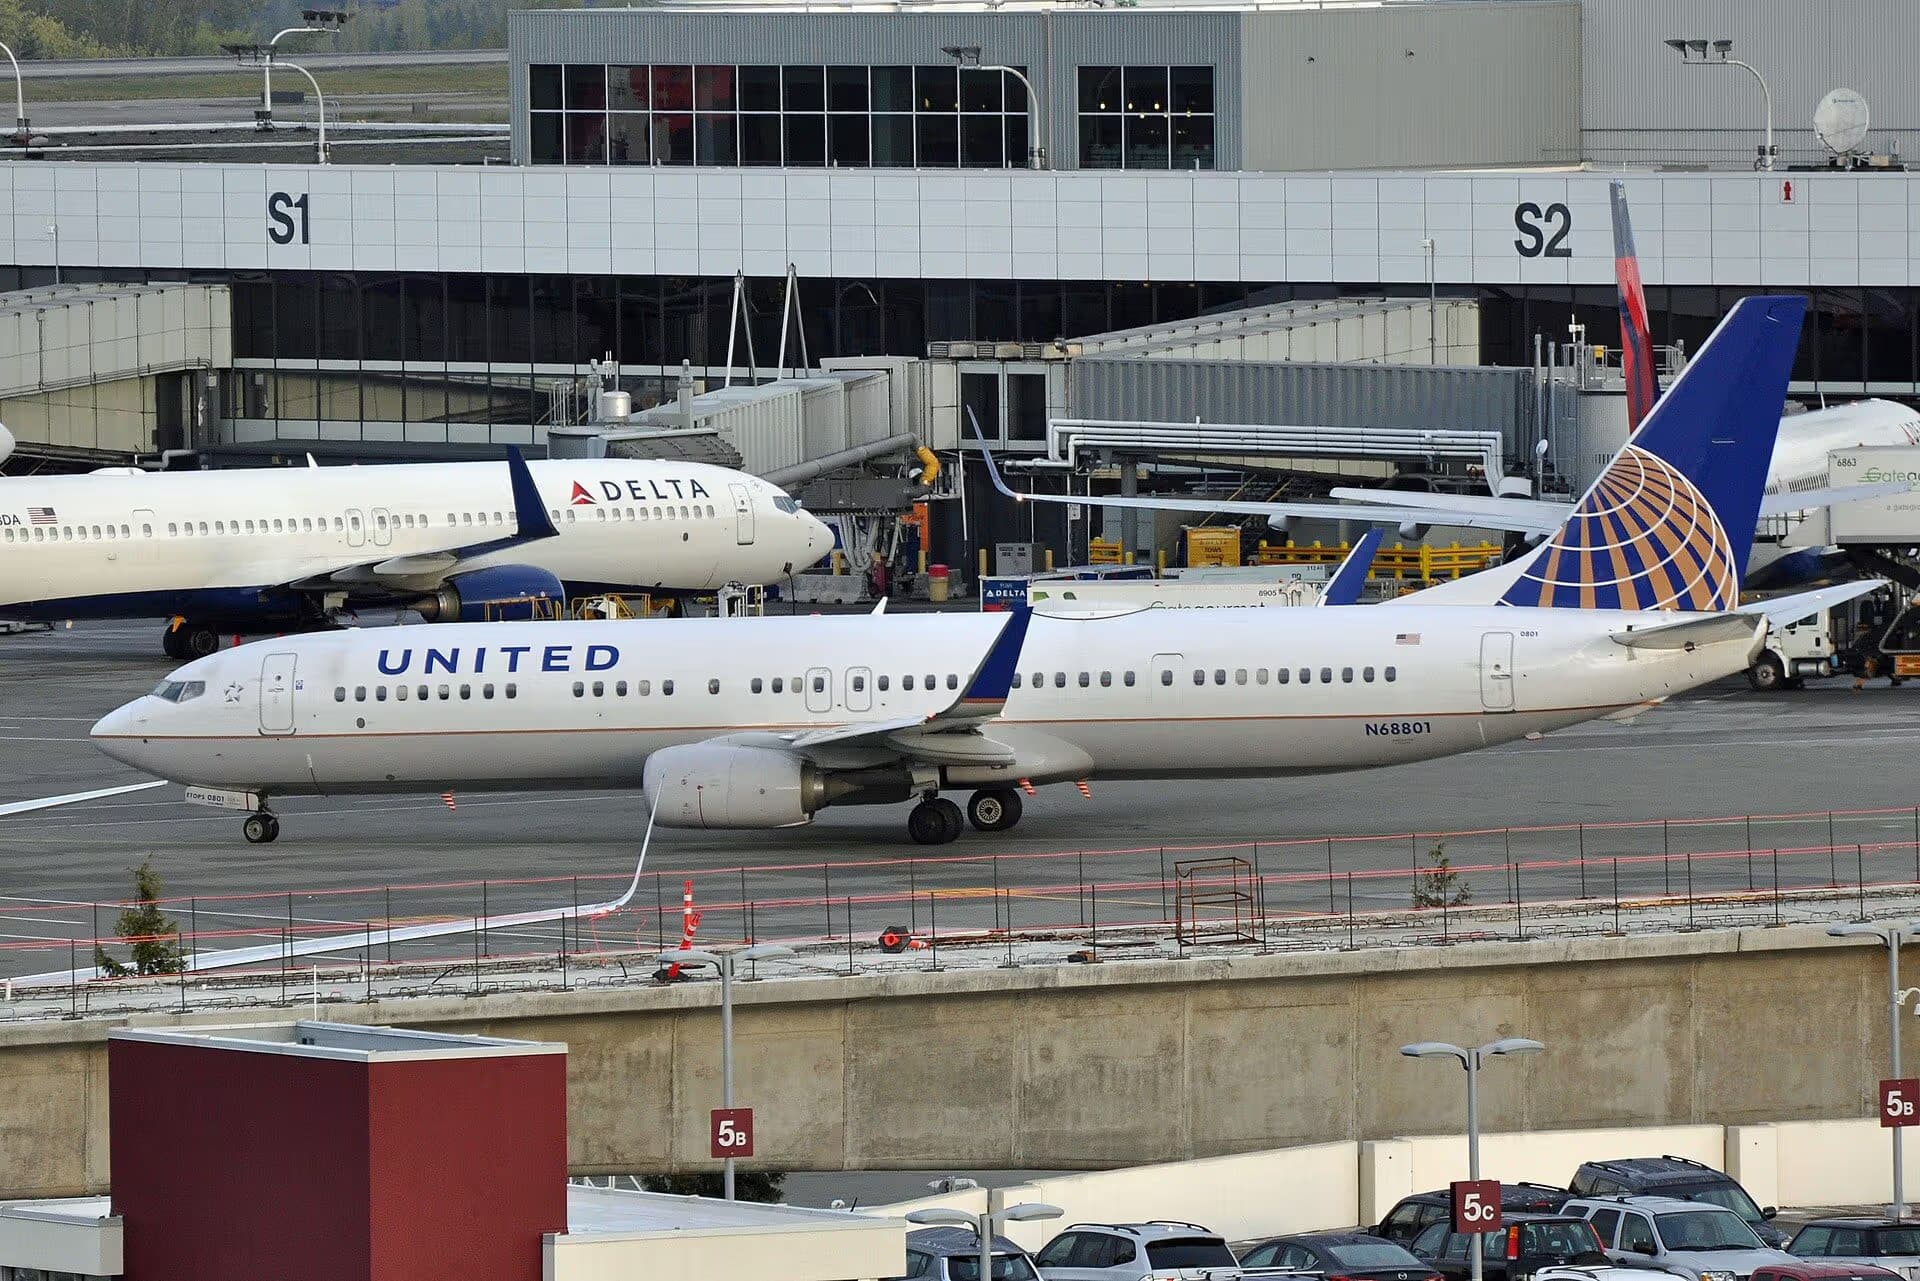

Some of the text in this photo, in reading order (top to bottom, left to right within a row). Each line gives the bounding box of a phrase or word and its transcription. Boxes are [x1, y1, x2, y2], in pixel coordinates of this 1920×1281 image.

[268, 191, 309, 245] S1
[1514, 202, 1572, 258] S2
[1860, 466, 1920, 484] Gateg
[599, 479, 710, 501] DELTA
[0, 514, 21, 526] DA
[995, 589, 1026, 597] DELTA
[377, 645, 621, 676] UNITED
[1365, 721, 1432, 736] N68801
